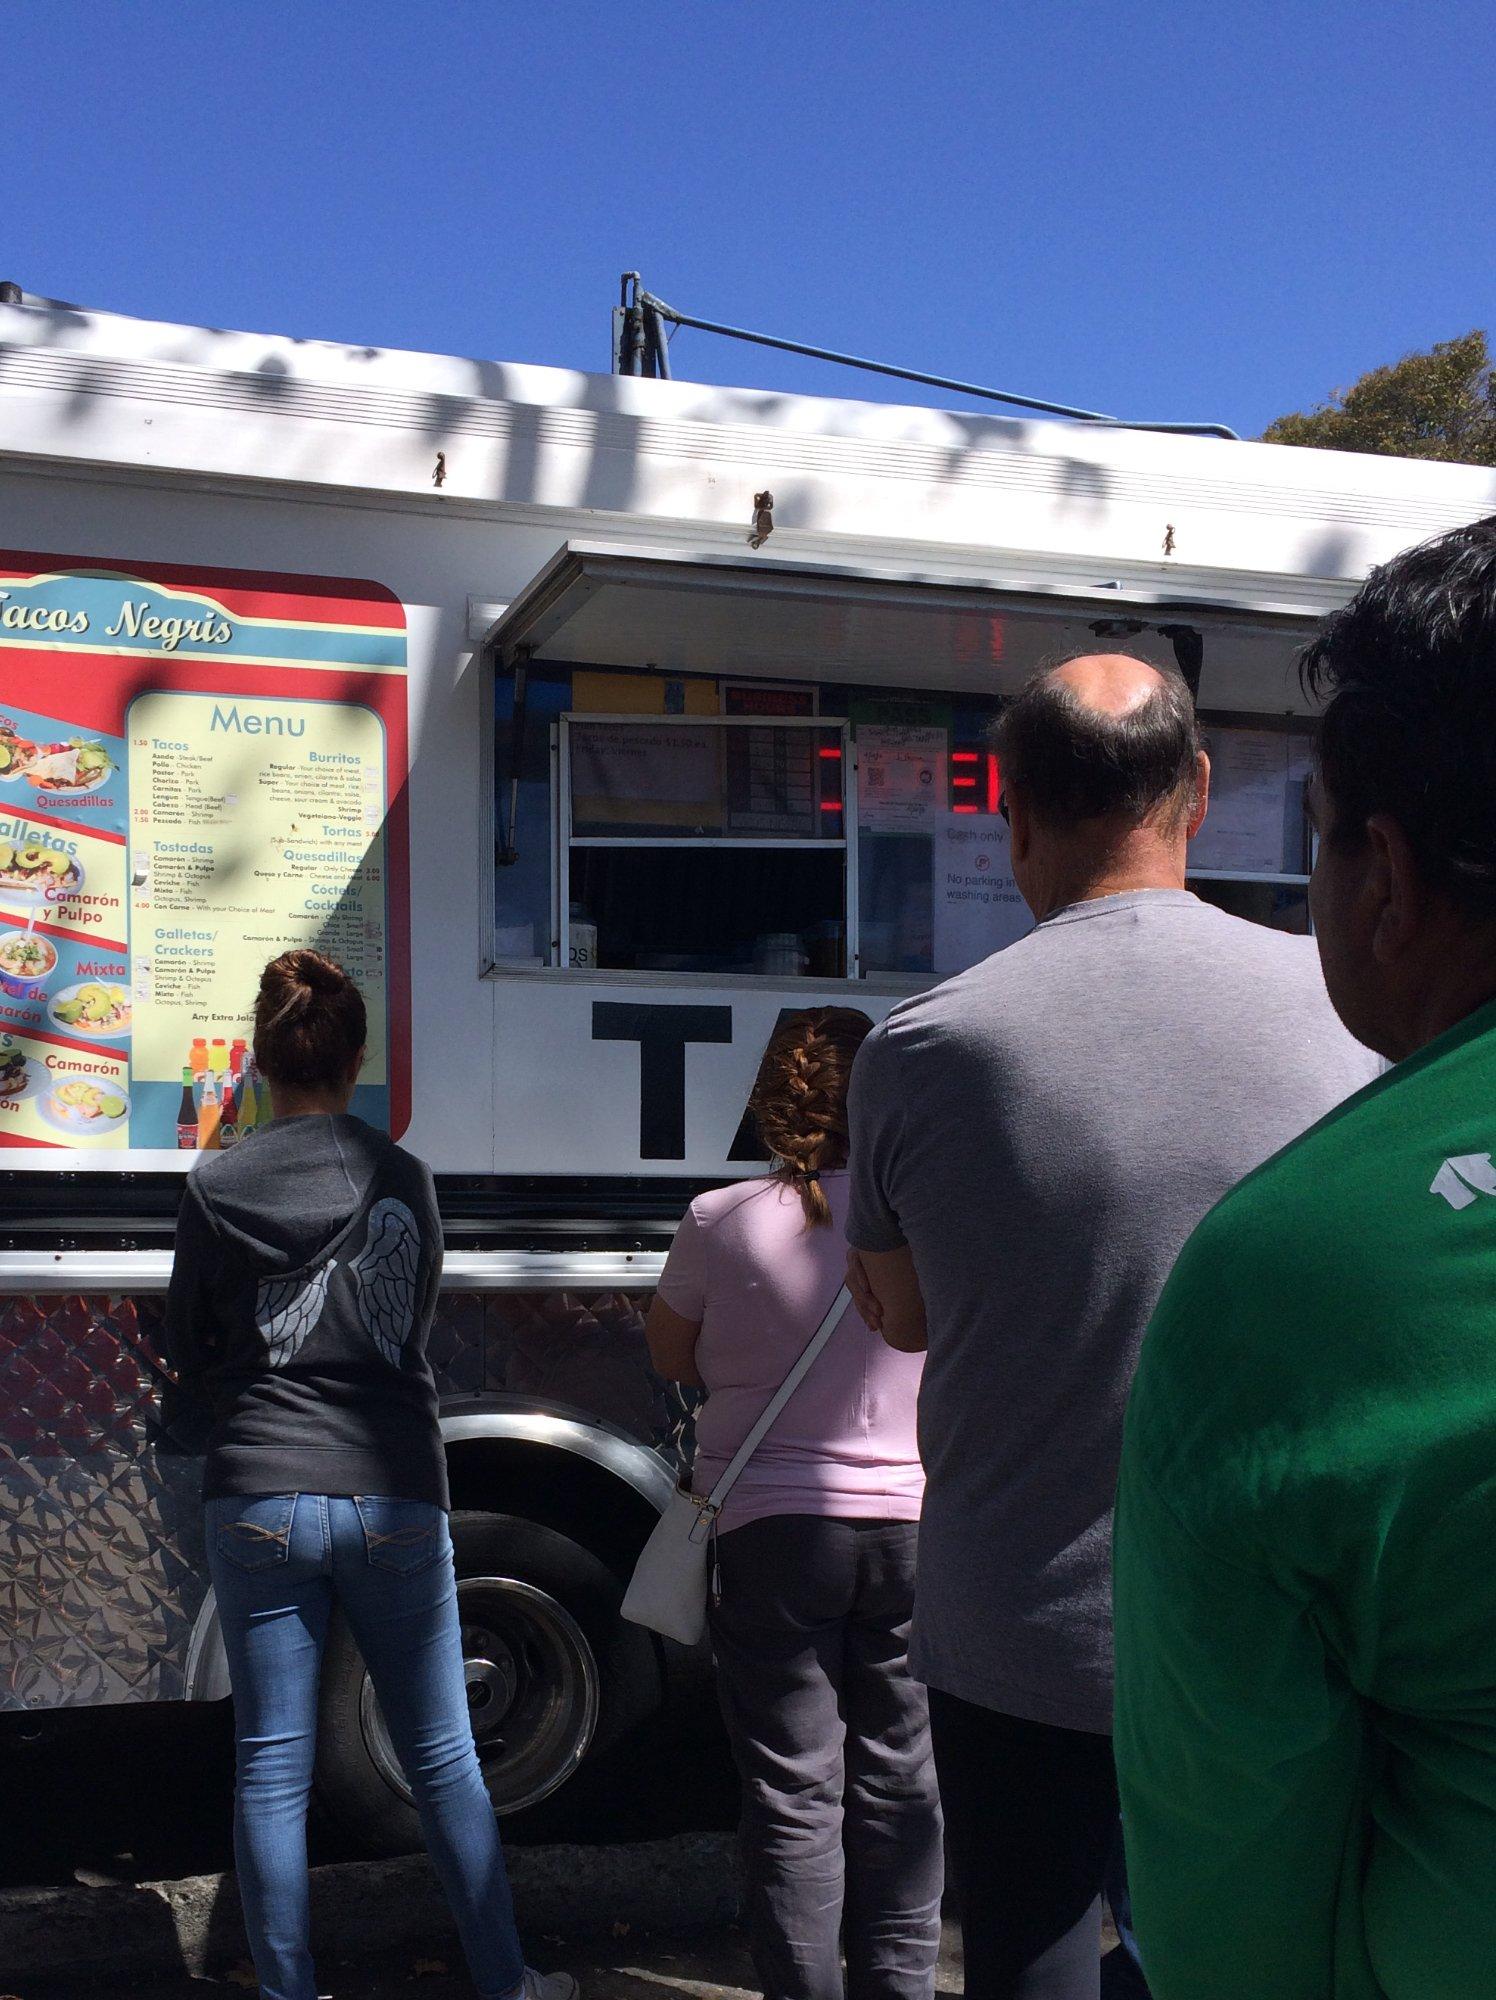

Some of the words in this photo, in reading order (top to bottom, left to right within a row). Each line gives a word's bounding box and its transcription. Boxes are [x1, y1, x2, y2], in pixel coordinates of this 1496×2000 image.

[105, 601, 234, 651] Negris
[210, 705, 305, 736] Menu
[152, 739, 189, 750] Tacos
[309, 752, 362, 764] Burritos
[36, 795, 115, 811] Quesadillas
[323, 825, 362, 837] Tortas
[947, 828, 977, 841] Cash
[980, 830, 1004, 844] only
[153, 841, 214, 854] Tostadas
[284, 850, 363, 864] Quesadillas
[947, 873, 962, 885] No
[965, 876, 1004, 889] parking
[44, 887, 120, 907] Camarón
[946, 890, 990, 904] washing
[992, 892, 1022, 903] areas
[304, 900, 363, 913] Cocktails
[43, 909, 52, 921] y
[57, 906, 103, 925] Pulpo
[154, 928, 219, 941] Galletas/
[154, 944, 214, 956] Crackers
[76, 961, 126, 977] Mixta
[28, 987, 48, 1002] de
[191, 1013, 209, 1022] Any
[211, 1013, 233, 1021] Extra
[45, 1055, 120, 1077] Camarón
